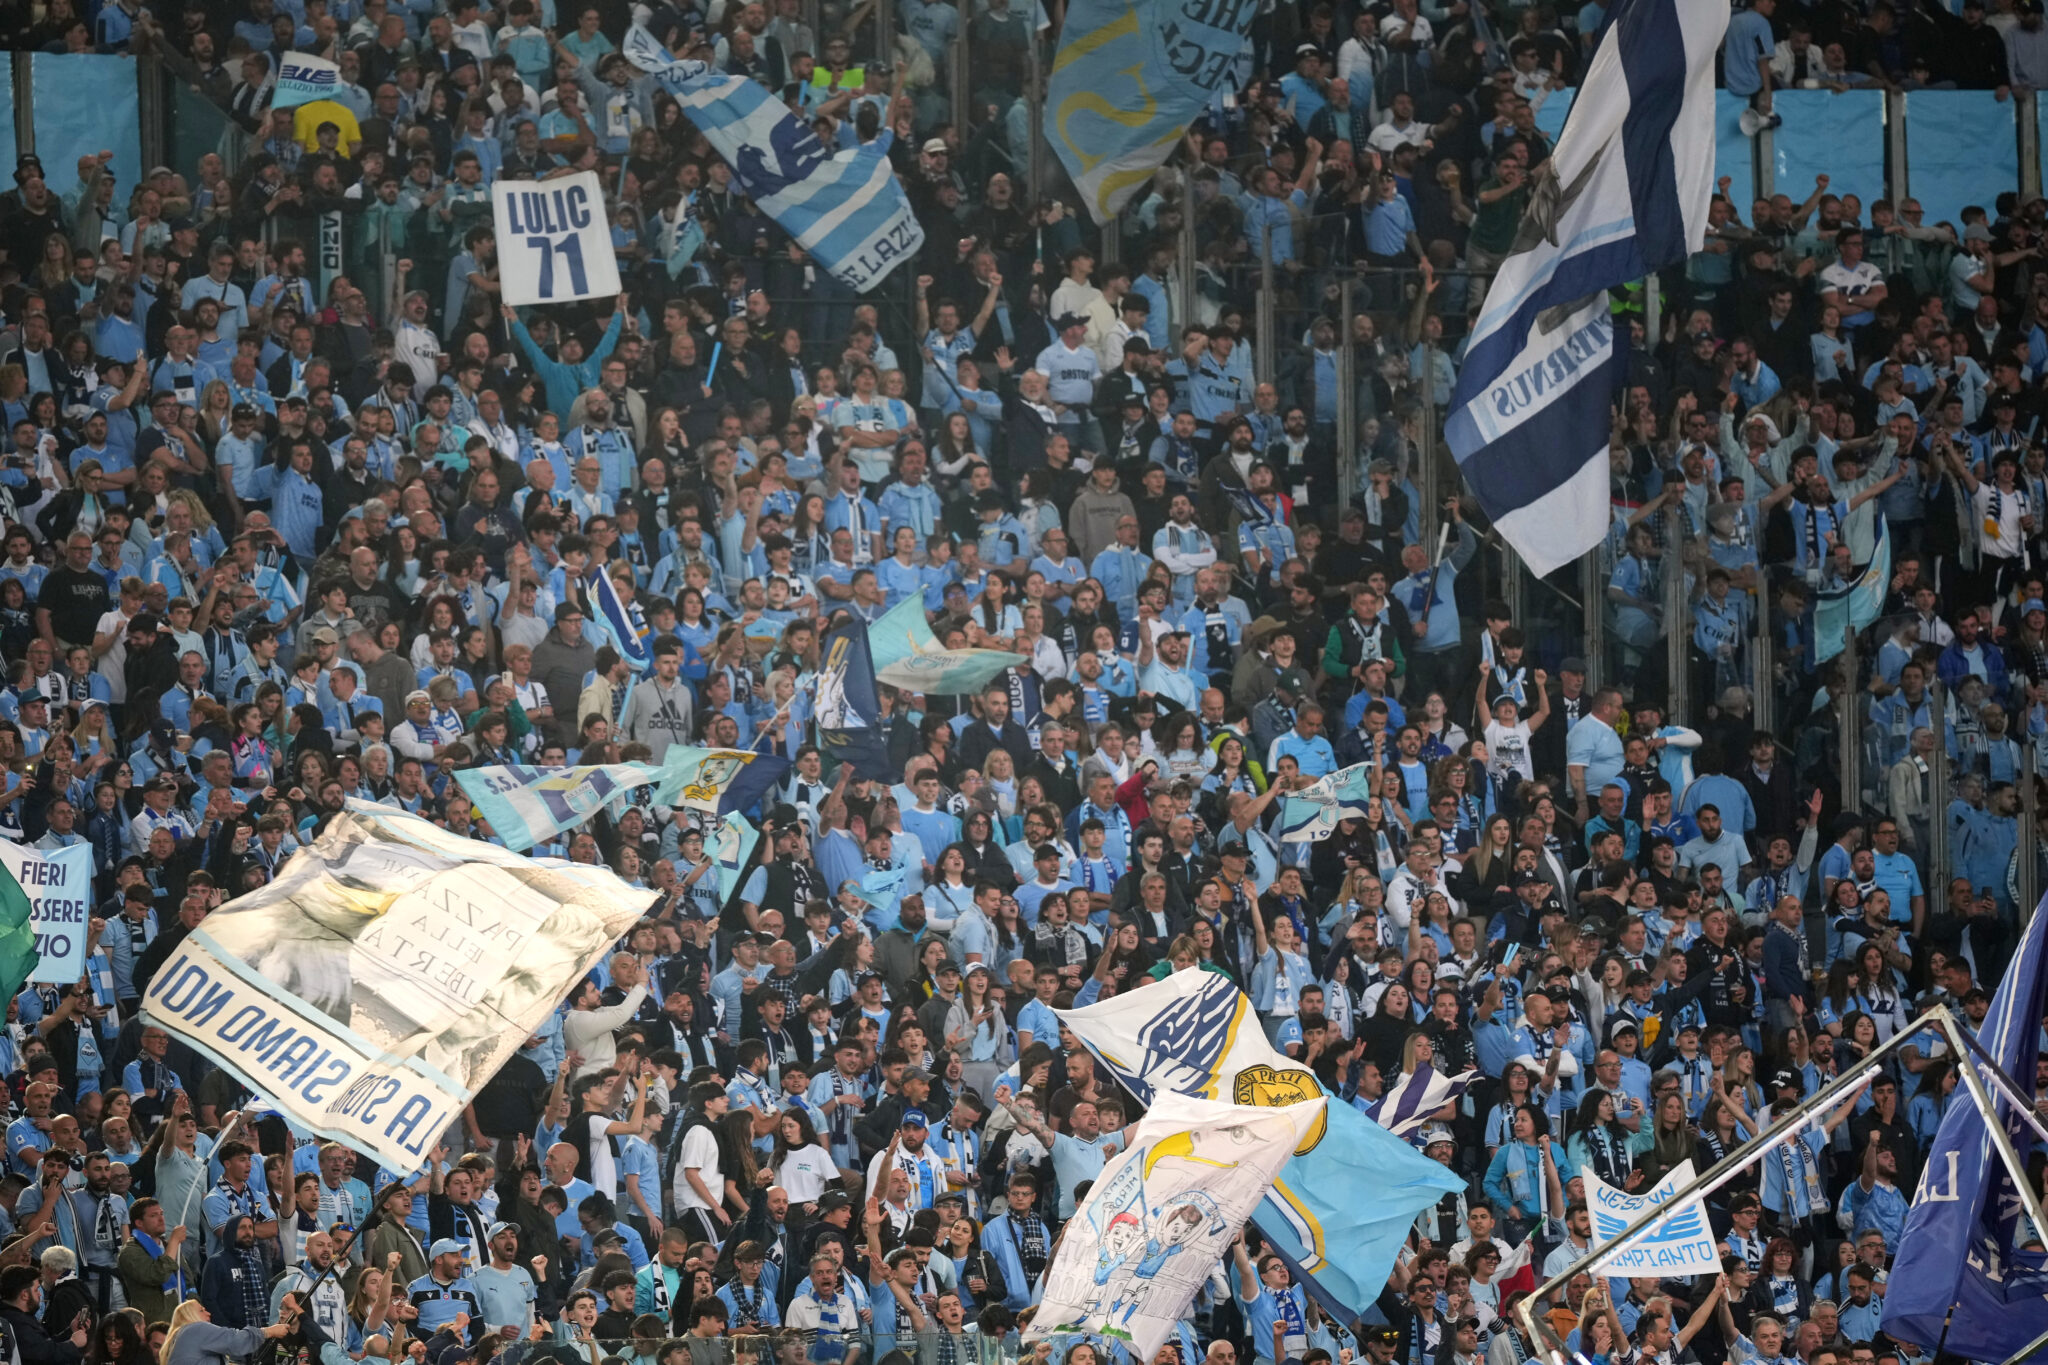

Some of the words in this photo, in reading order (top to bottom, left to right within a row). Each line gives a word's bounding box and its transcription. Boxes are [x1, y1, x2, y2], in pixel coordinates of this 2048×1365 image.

[506, 185, 591, 234] LULIC
[526, 232, 590, 298] 71
[20, 860, 67, 887] FIERI
[28, 898, 84, 924] SSERE
[1259, 1070, 1304, 1085] PRATI
